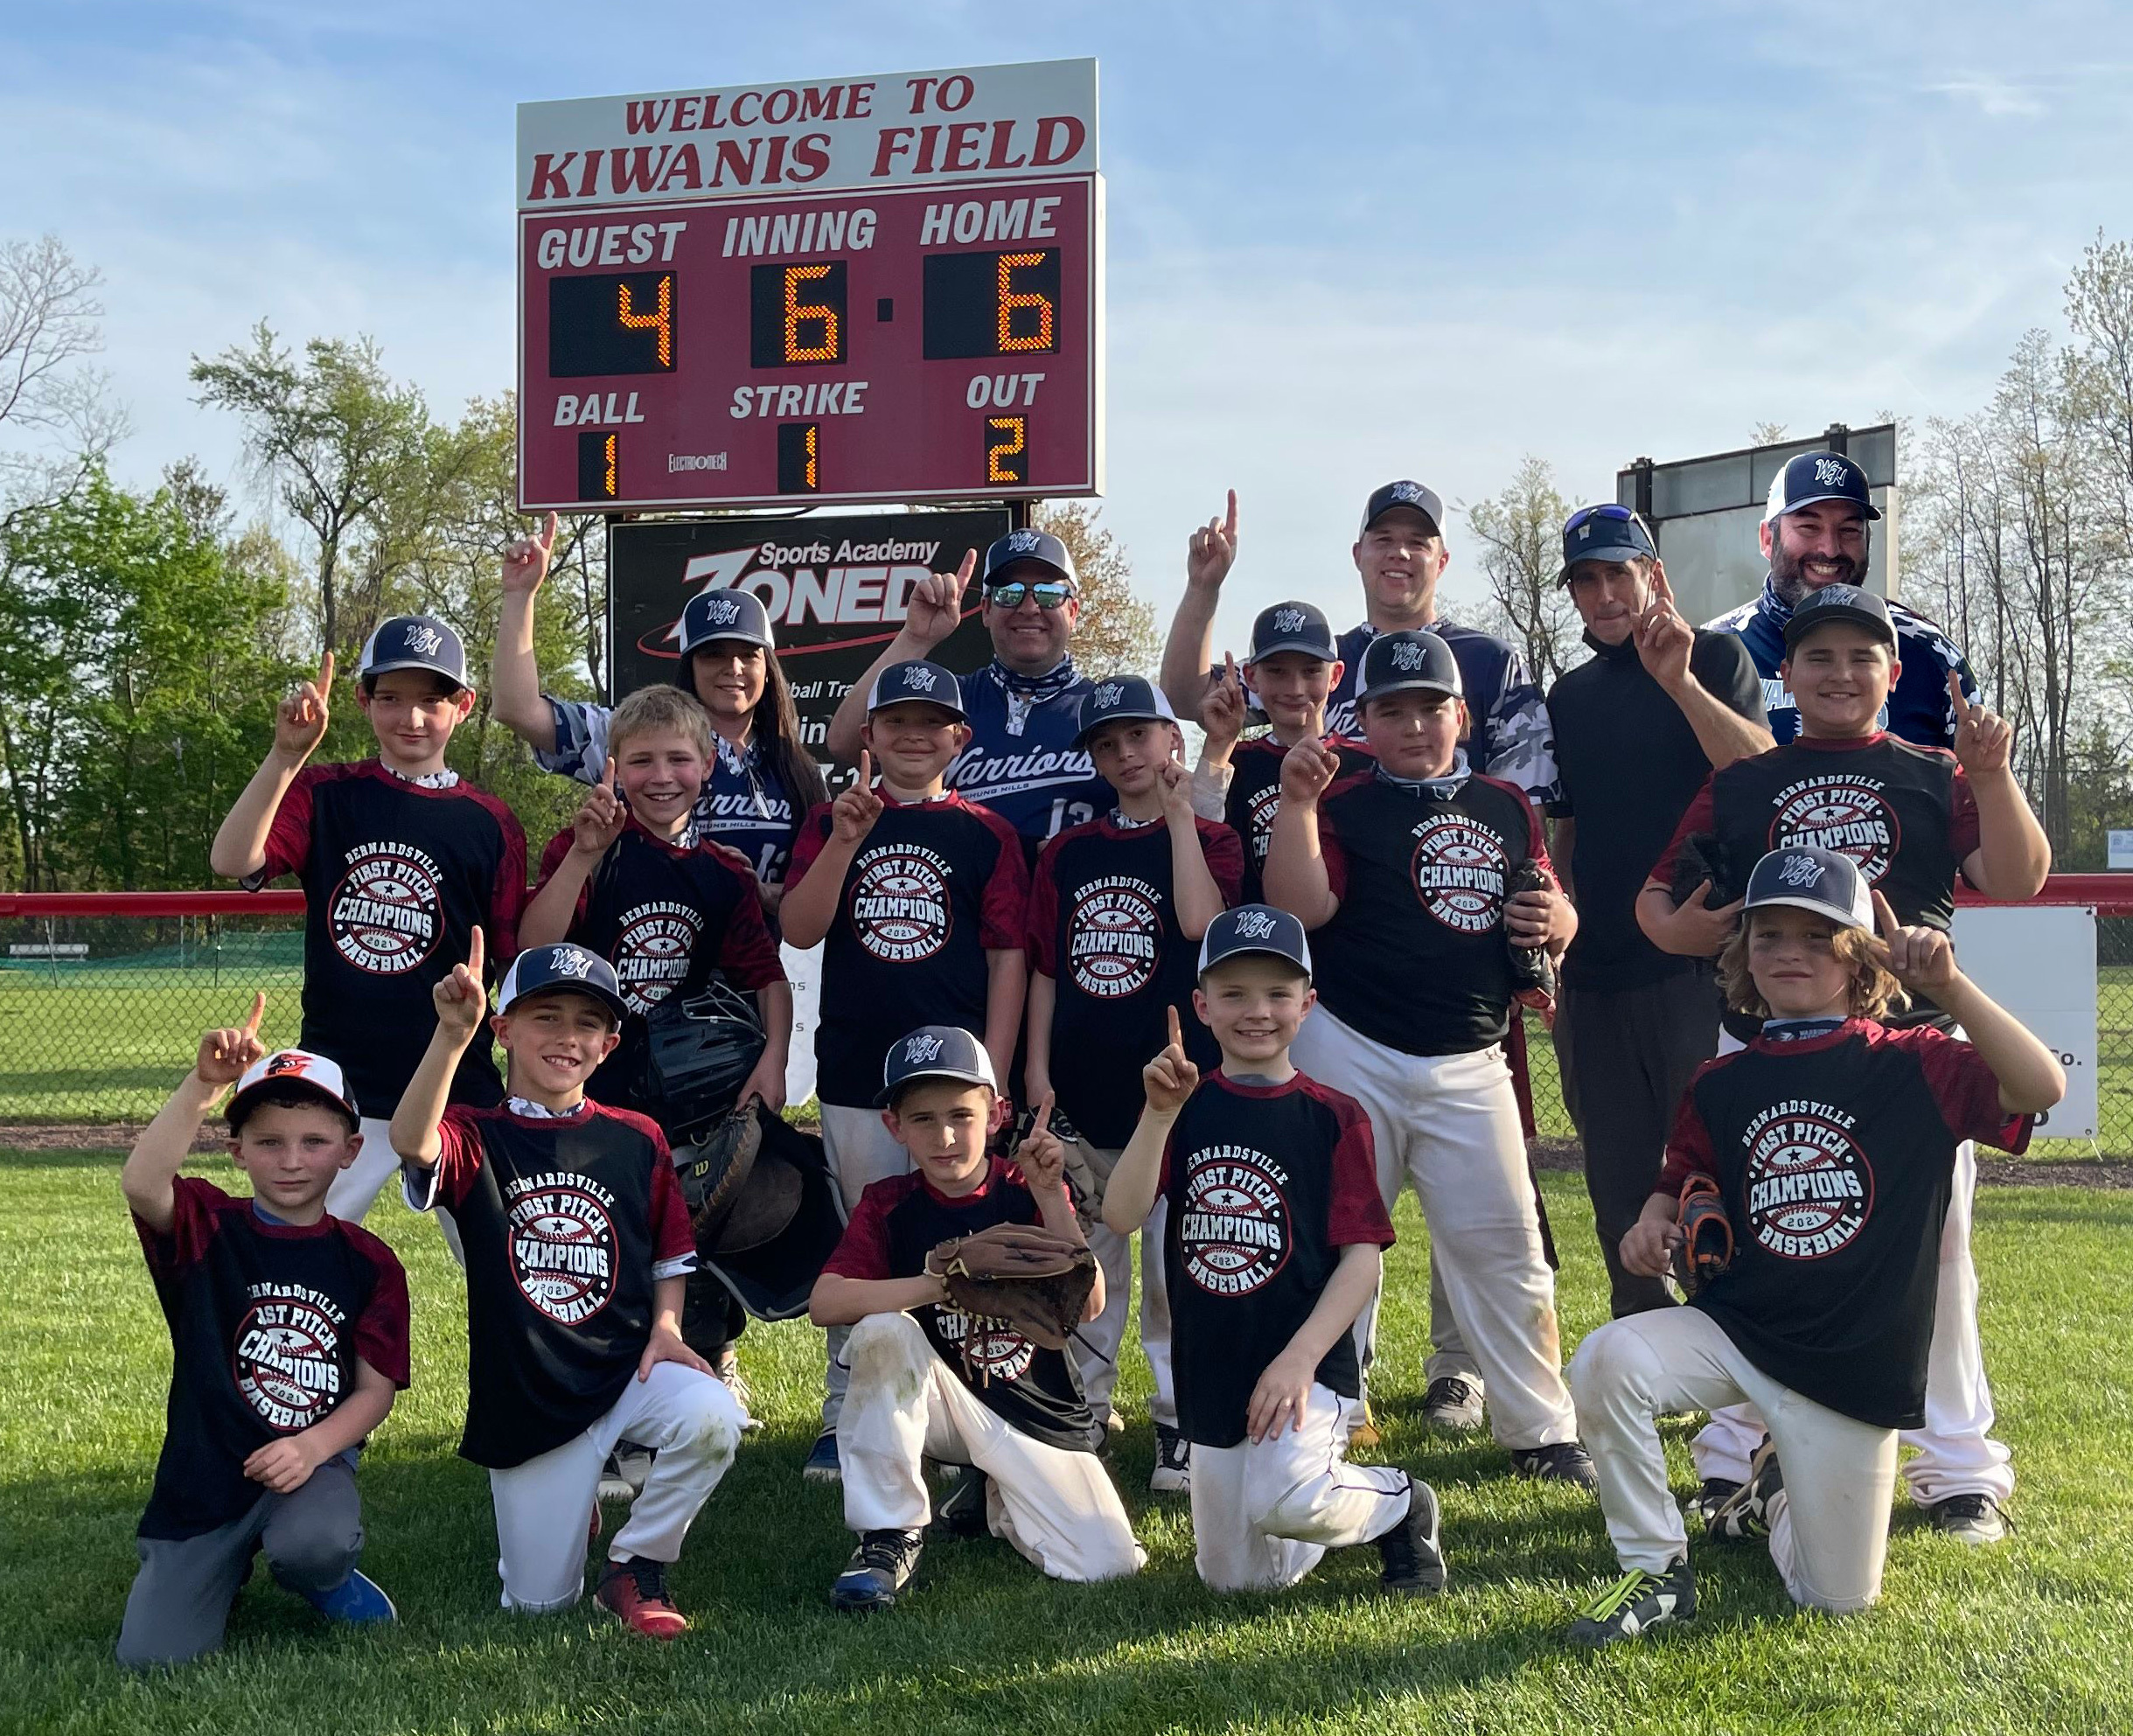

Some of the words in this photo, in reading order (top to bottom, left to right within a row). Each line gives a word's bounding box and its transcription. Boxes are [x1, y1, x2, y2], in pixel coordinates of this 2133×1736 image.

[625, 83, 876, 136] WELCOME
[906, 74, 975, 114] TO
[526, 133, 832, 201] KIWANIS
[869, 115, 1087, 178] FIELD
[721, 208, 878, 258] INNING
[919, 196, 1062, 246] HOME
[537, 221, 687, 269] GUEST
[785, 264, 839, 363] 6
[997, 251, 1053, 352] 6
[618, 275, 672, 367] 4
[554, 391, 645, 426] BALL
[729, 380, 869, 418] STRIKE
[965, 373, 1046, 409] OUT
[603, 433, 617, 497] 1
[805, 425, 817, 489] 1
[988, 417, 1026, 483] 2
[758, 542, 830, 569] Sports
[833, 538, 941, 565] Academy
[790, 680, 823, 699] ball
[1772, 774, 1886, 808] BERNARDSVILLE
[1781, 791, 1825, 825] FIRST
[1829, 789, 1880, 813] PITCH
[1412, 813, 1504, 846] BERNARDSVILLE
[1421, 829, 1459, 857] FIRST
[1462, 830, 1502, 863] PITCH
[345, 841, 443, 884] BERNARDSVILLE
[857, 843, 952, 877] BERNARDSVILLE
[861, 859, 901, 889] FIRST
[903, 860, 944, 896] PITCH
[348, 861, 392, 889] FIRST
[393, 862, 436, 903] PITCH
[1074, 875, 1162, 904] BERNARDSVILLE
[1419, 865, 1504, 897] CHAMPIONS
[333, 896, 433, 939] CHAMPIONS
[854, 896, 945, 927] CHAMPIONS
[1077, 893, 1114, 924] FIRST
[1115, 894, 1155, 926] PITCH
[1429, 897, 1502, 931] BASEBALL
[1454, 898, 1479, 909] 2021
[366, 937, 393, 948] 2021
[623, 919, 664, 948] FIRST
[666, 920, 694, 951] PITC
[861, 930, 943, 960] BASEBALL
[886, 929, 912, 938] 2021
[1070, 931, 1154, 959] CHAMPIONS
[337, 933, 424, 972] BASEBALL
[617, 959, 690, 980] CHAMPIONS
[1095, 964, 1119, 973] 2021
[1076, 966, 1148, 996] BASEBALL
[1741, 1099, 1857, 1147] BERNARDSVILLE
[1751, 1124, 1788, 1170] FIRST
[1793, 1122, 1851, 1159] PITCH
[1187, 1145, 1289, 1186] ERNARDSVILLE
[1187, 1167, 1226, 1203] FIRST
[1230, 1168, 1280, 1210] PITCH
[1749, 1169, 1864, 1215] CHAMPIONS
[559, 1195, 609, 1235] PITCH
[1182, 1213, 1282, 1251] CHAMPIONS
[1787, 1214, 1822, 1228] 2021
[1758, 1214, 1864, 1257] BASEBALL
[1187, 1256, 1274, 1293] BASEBALL
[1211, 1255, 1237, 1265] 2021
[290, 1307, 338, 1351] PITCH
[239, 1376, 328, 1427] BASEBALL
[268, 1386, 301, 1404] 2021
